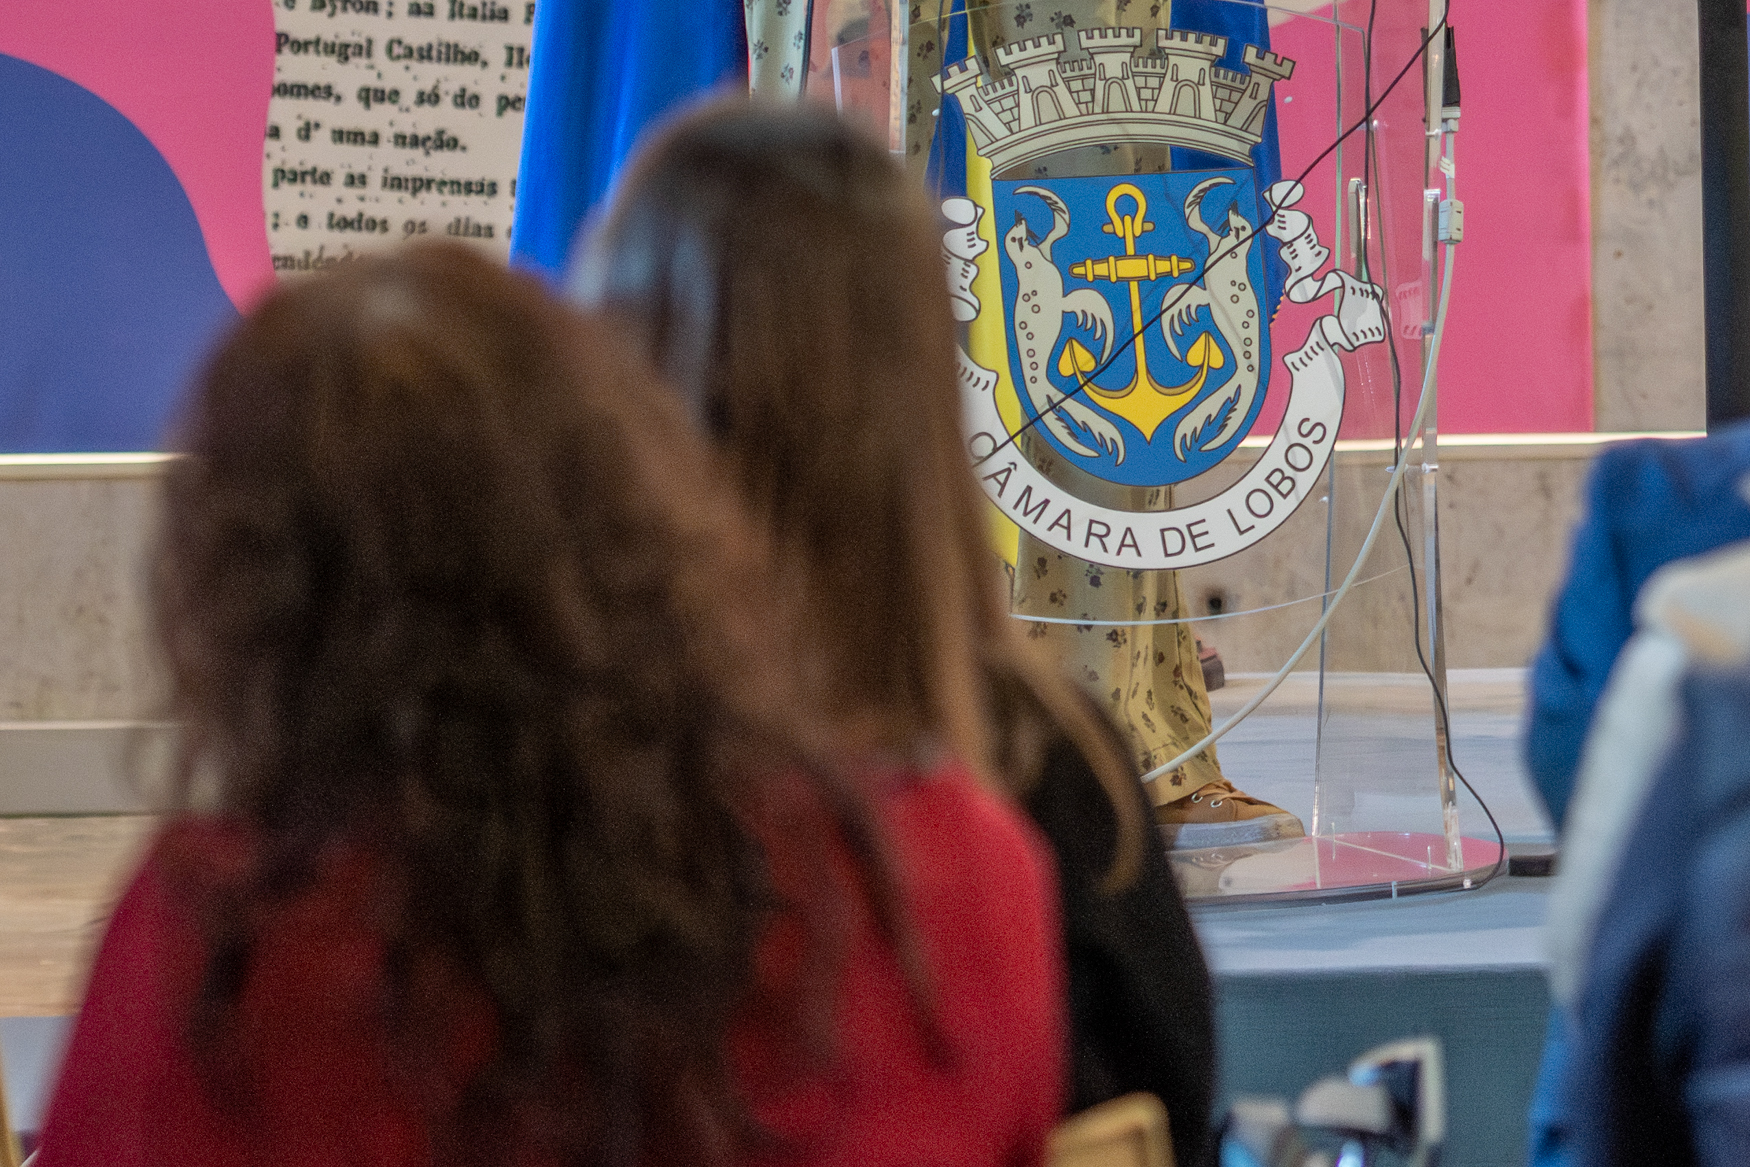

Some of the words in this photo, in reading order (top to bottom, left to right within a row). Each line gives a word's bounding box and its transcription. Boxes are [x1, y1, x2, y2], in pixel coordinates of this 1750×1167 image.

[408, 0, 435, 19] na
[277, 32, 374, 67] Portugal
[385, 37, 489, 70] Castilho,
[357, 87, 402, 111] que
[415, 79, 440, 107] só
[452, 87, 481, 111] de
[331, 127, 381, 149] uma
[392, 128, 468, 157] nação.
[271, 166, 333, 190] parte
[343, 172, 368, 189] as
[380, 166, 499, 199] imprensas
[327, 212, 389, 235] todos
[970, 429, 1143, 560] CÂMARA
[1159, 519, 1216, 560] DE
[1228, 415, 1328, 537] LOBOS
